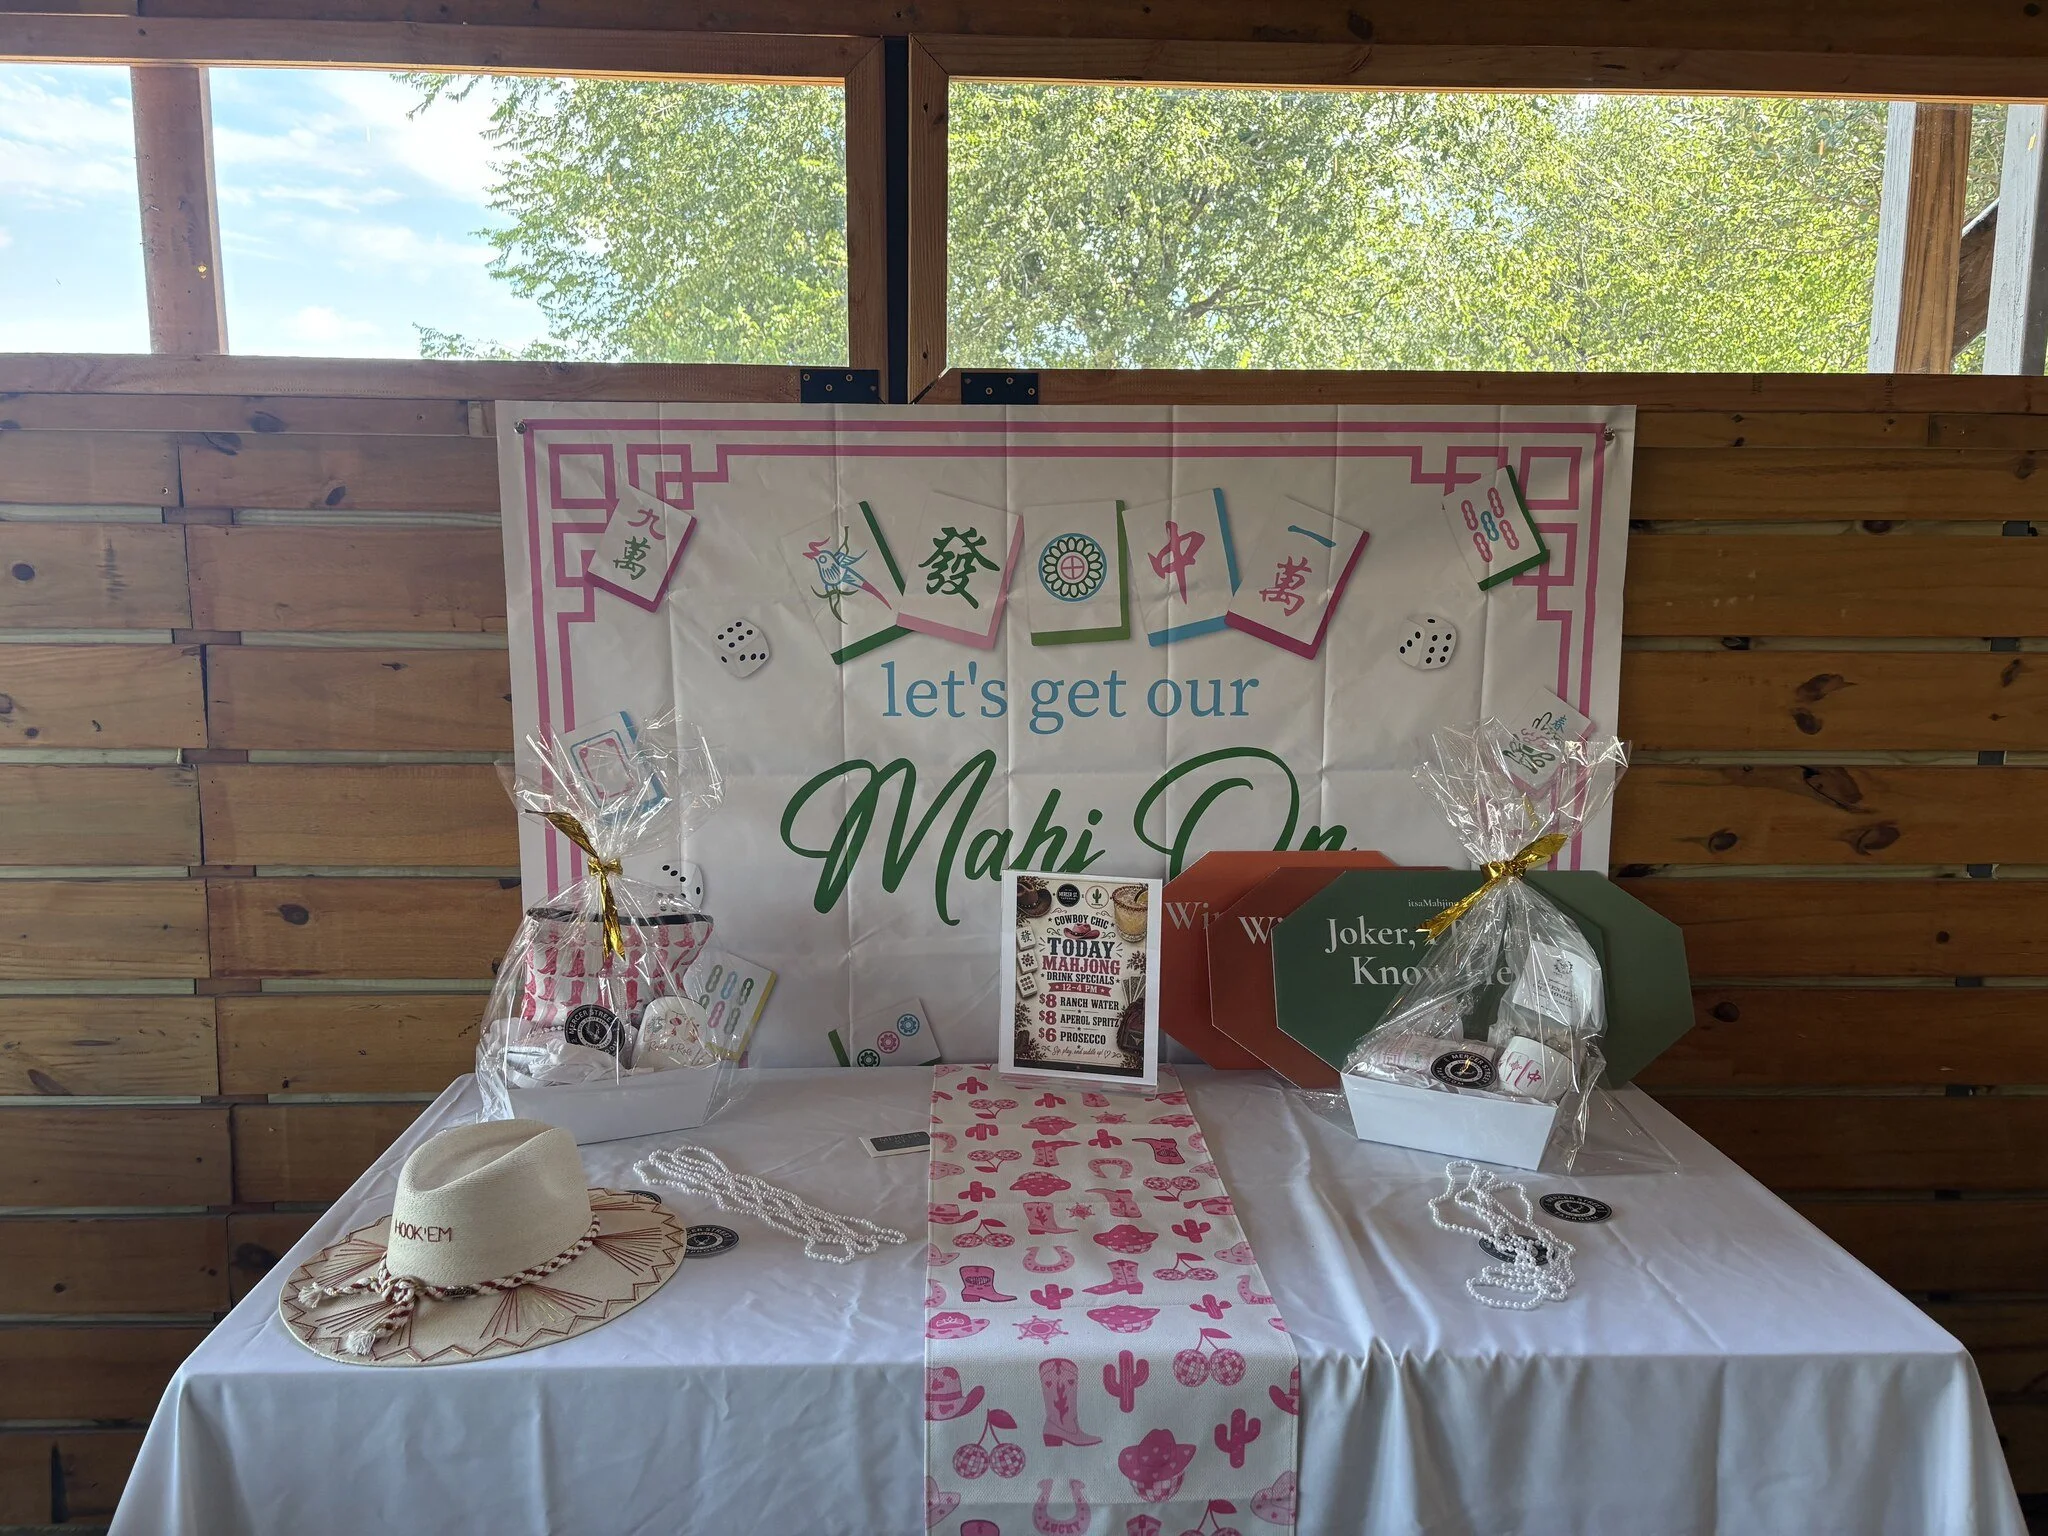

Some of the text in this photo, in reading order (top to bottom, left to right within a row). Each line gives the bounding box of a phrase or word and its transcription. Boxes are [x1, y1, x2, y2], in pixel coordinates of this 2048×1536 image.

[917, 526, 1001, 610] 發
[1147, 520, 1206, 605] 中
[880, 660, 1261, 735] let's get our
[1054, 914, 1109, 930] COWBOY CHIC
[1164, 902, 1224, 930] Wi
[1237, 916, 1284, 945] W
[1324, 915, 1416, 954] Joker,
[1047, 937, 1115, 959] TODAY
[1042, 955, 1121, 976] MAHJONG
[1046, 971, 1115, 985] DRINK SPECIALS
[1084, 985, 1098, 993] PM
[1039, 993, 1120, 1011] $8 RANCH WATER
[568, 1009, 589, 1035] MERCER
[589, 1009, 614, 1023] STREE
[1038, 1010, 1120, 1028] $8 APEROL SPRITZ
[1038, 1027, 1106, 1045] $6 PROSECCO
[1451, 1053, 1484, 1065] MERCER
[394, 1217, 452, 1243] HOOK'EM
[1032, 1263, 1067, 1272] LUCKY
[1042, 1521, 1081, 1534] LUCKY
